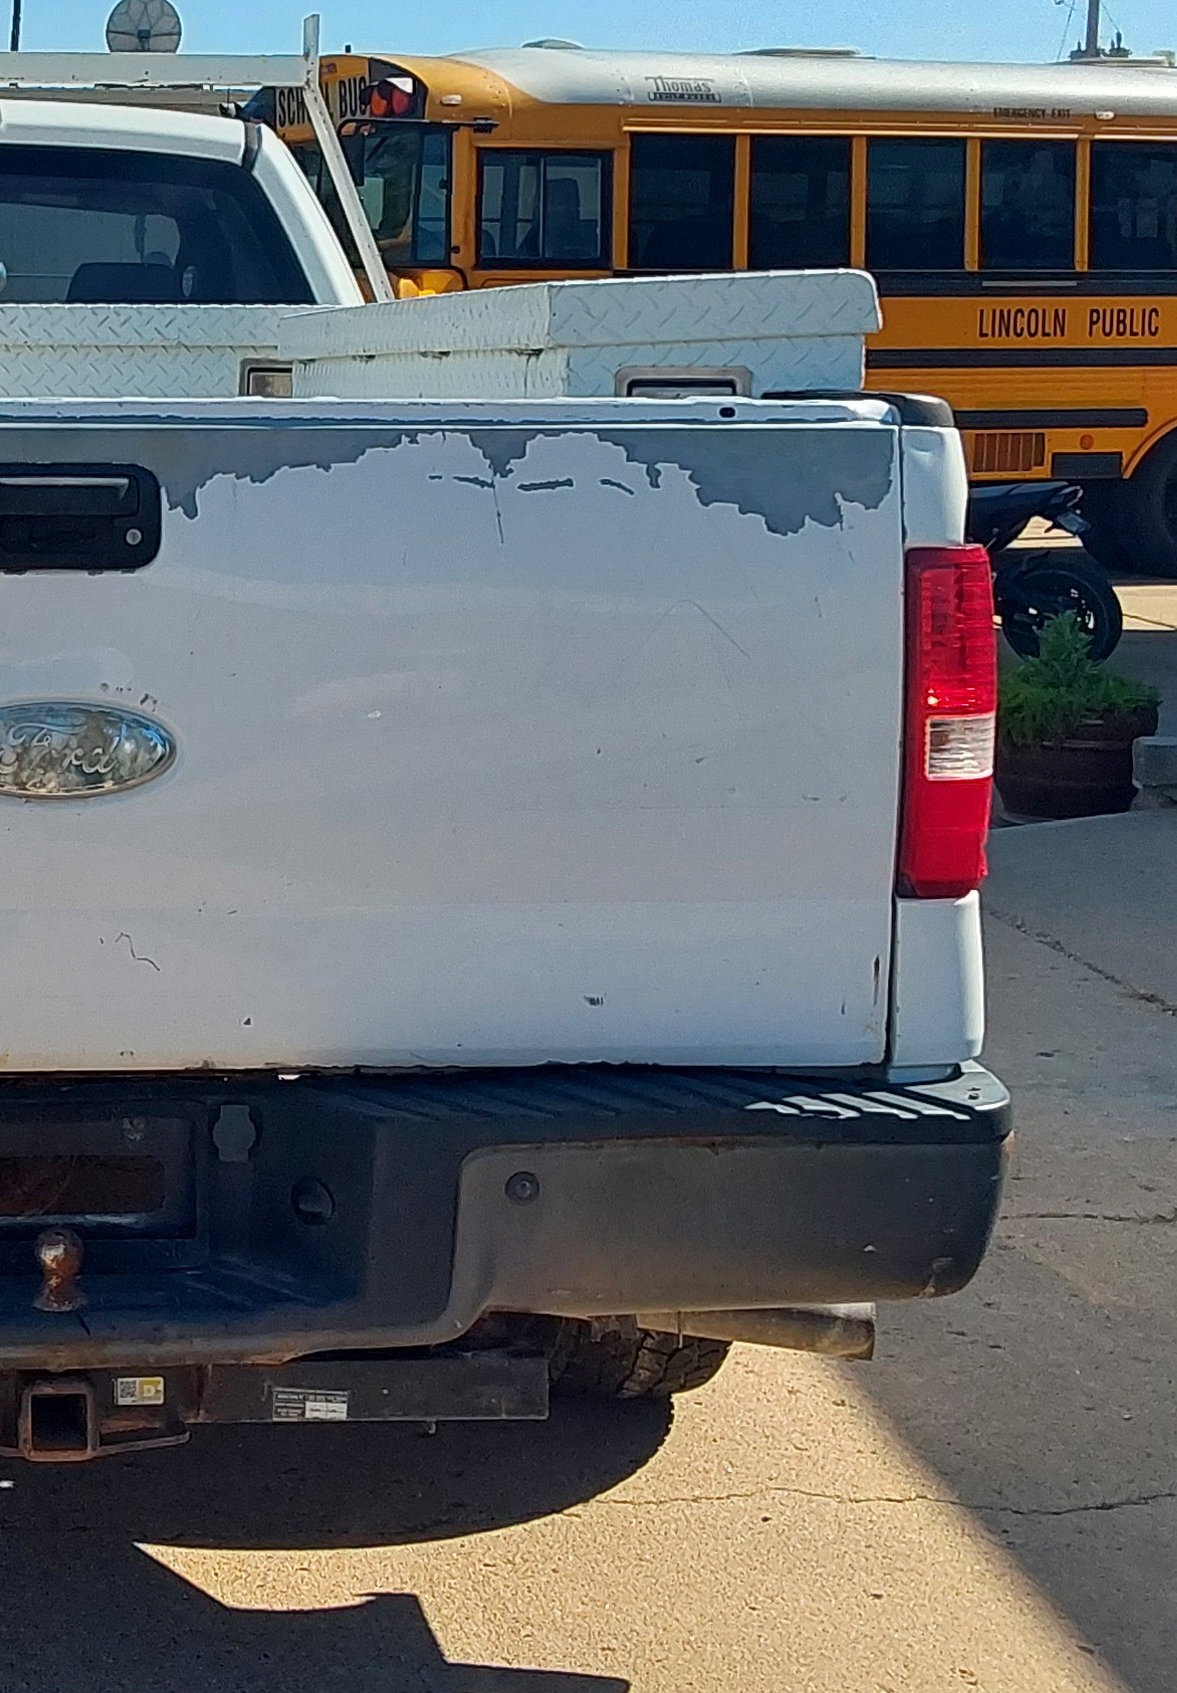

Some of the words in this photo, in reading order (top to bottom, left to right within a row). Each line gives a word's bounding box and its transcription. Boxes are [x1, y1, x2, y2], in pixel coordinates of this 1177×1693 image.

[645, 75, 715, 92] Thomas
[1051, 108, 1071, 118] EXIT
[978, 307, 1066, 338] LINCOLN
[1088, 307, 1159, 338] PUBLIC
